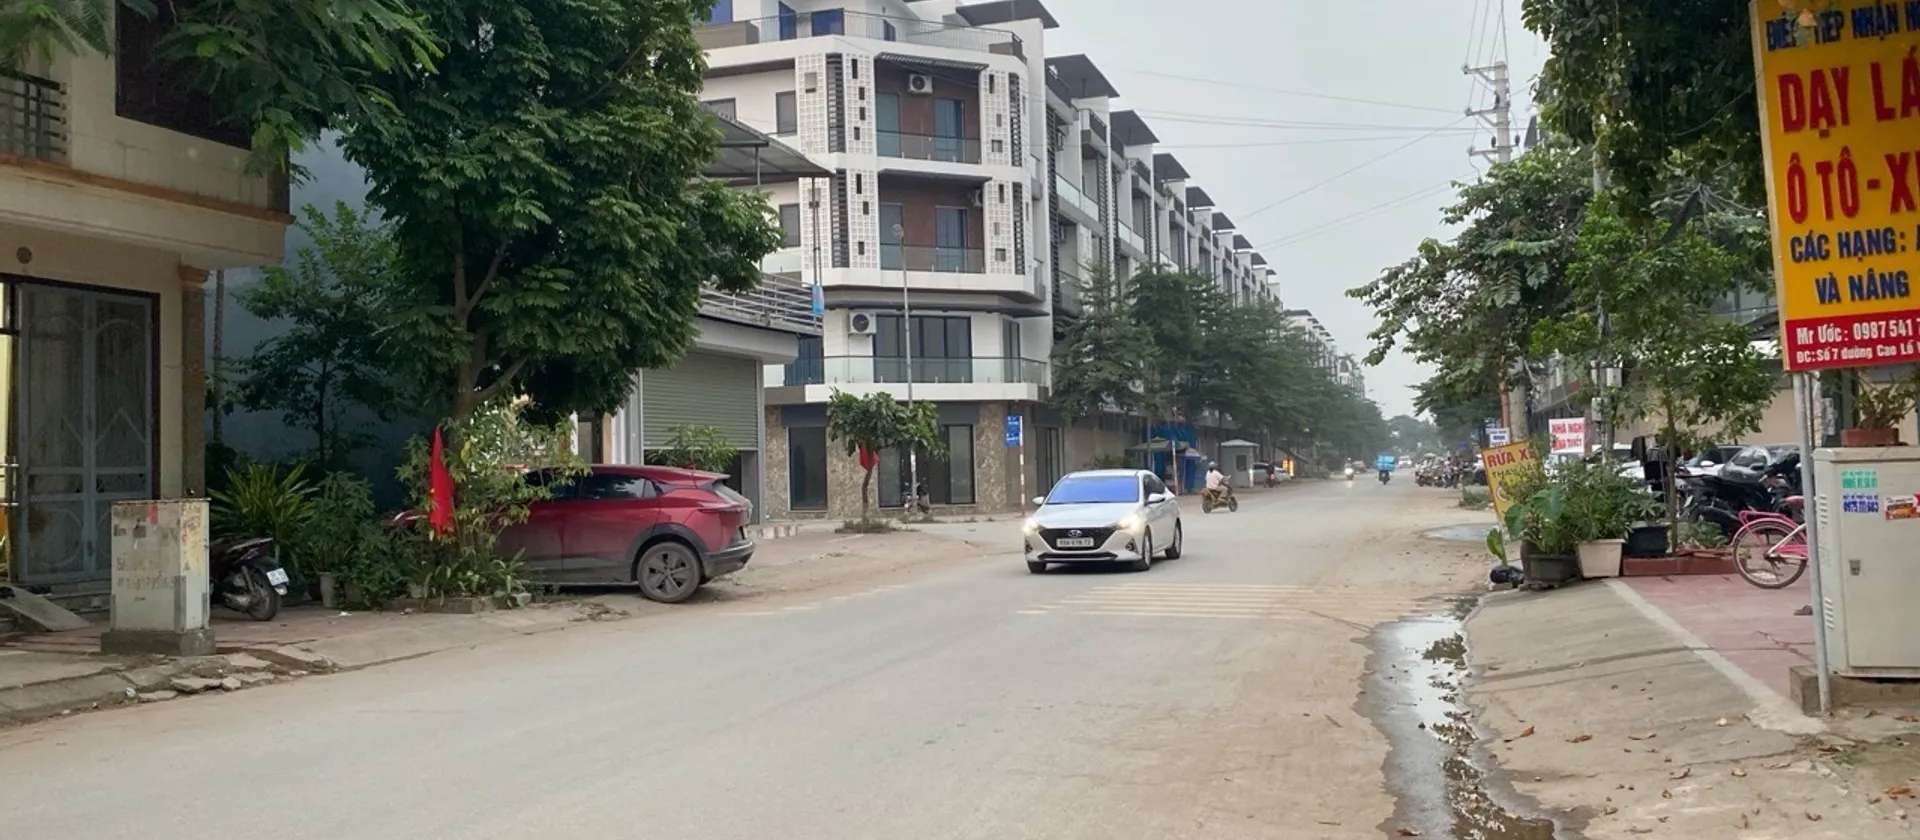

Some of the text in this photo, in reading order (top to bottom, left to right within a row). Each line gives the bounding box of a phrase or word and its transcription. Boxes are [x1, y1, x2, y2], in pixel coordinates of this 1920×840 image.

[1778, 66, 1850, 138] DẠY
[1787, 152, 1808, 224] Ô
[1815, 145, 1860, 221] TÔ
[1884, 150, 1920, 215] X
[1790, 229, 1831, 263] CÁC
[1814, 267, 1910, 305] VÀ NÂNG
[1796, 326, 1814, 345] Mr
[1853, 321, 1887, 341] 0987
[1889, 318, 1913, 337] 541
[1876, 344, 1897, 357] Cao
